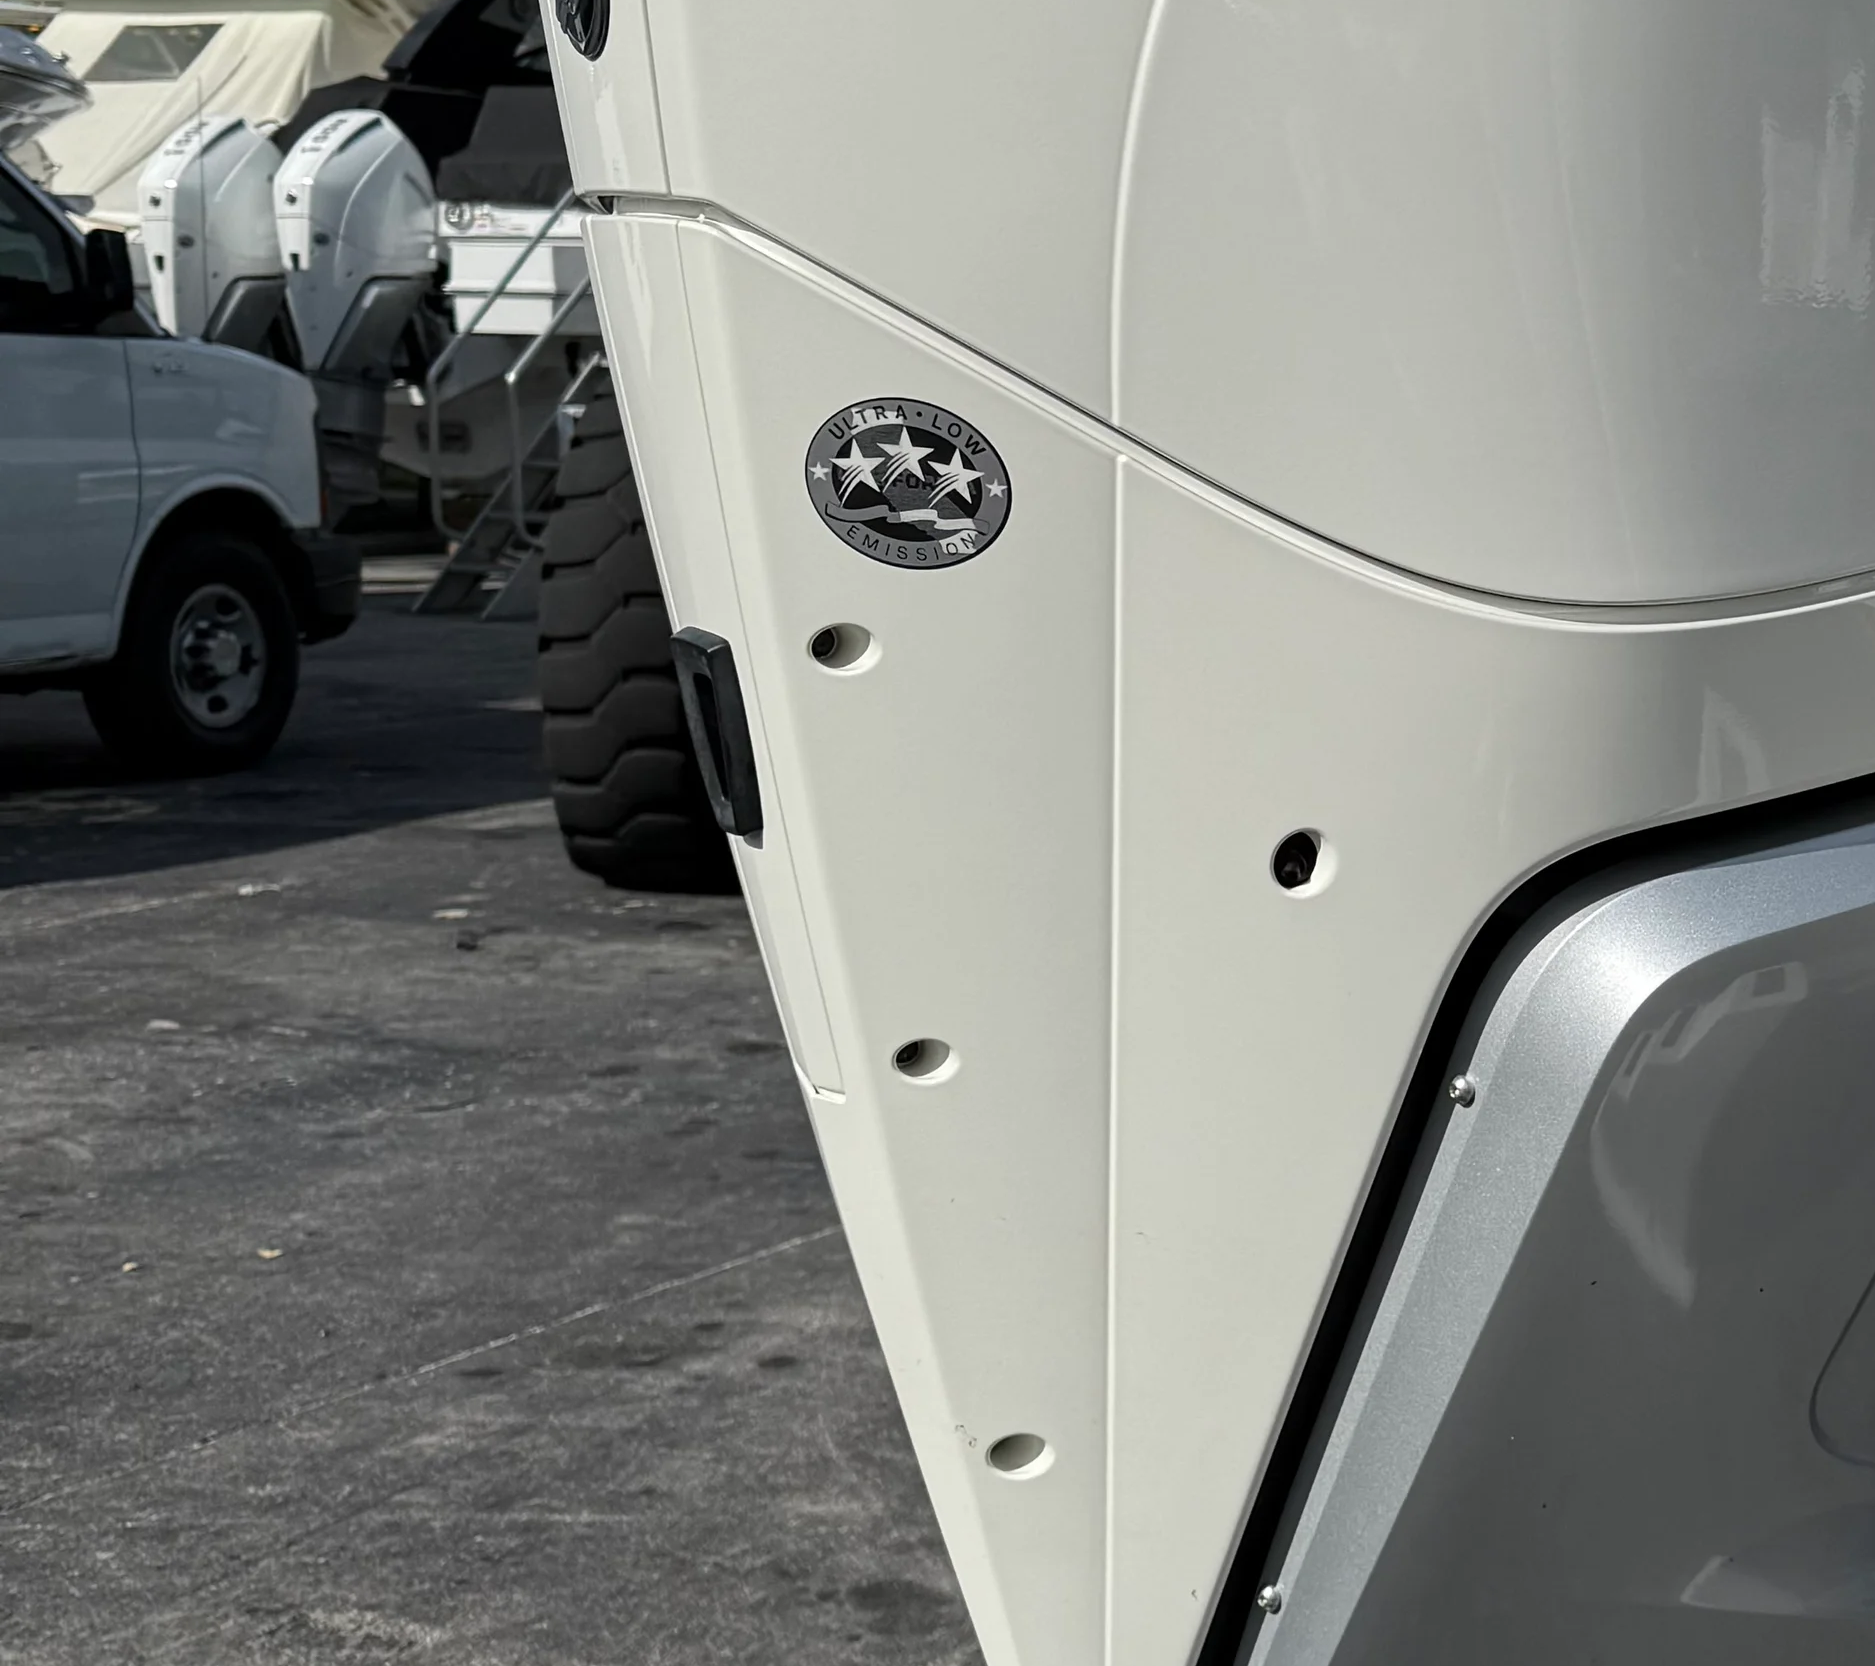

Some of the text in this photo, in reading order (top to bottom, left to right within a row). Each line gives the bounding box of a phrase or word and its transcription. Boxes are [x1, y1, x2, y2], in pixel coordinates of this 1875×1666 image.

[828, 404, 987, 457] ULTRA LOW
[847, 524, 979, 562] EMISSION
